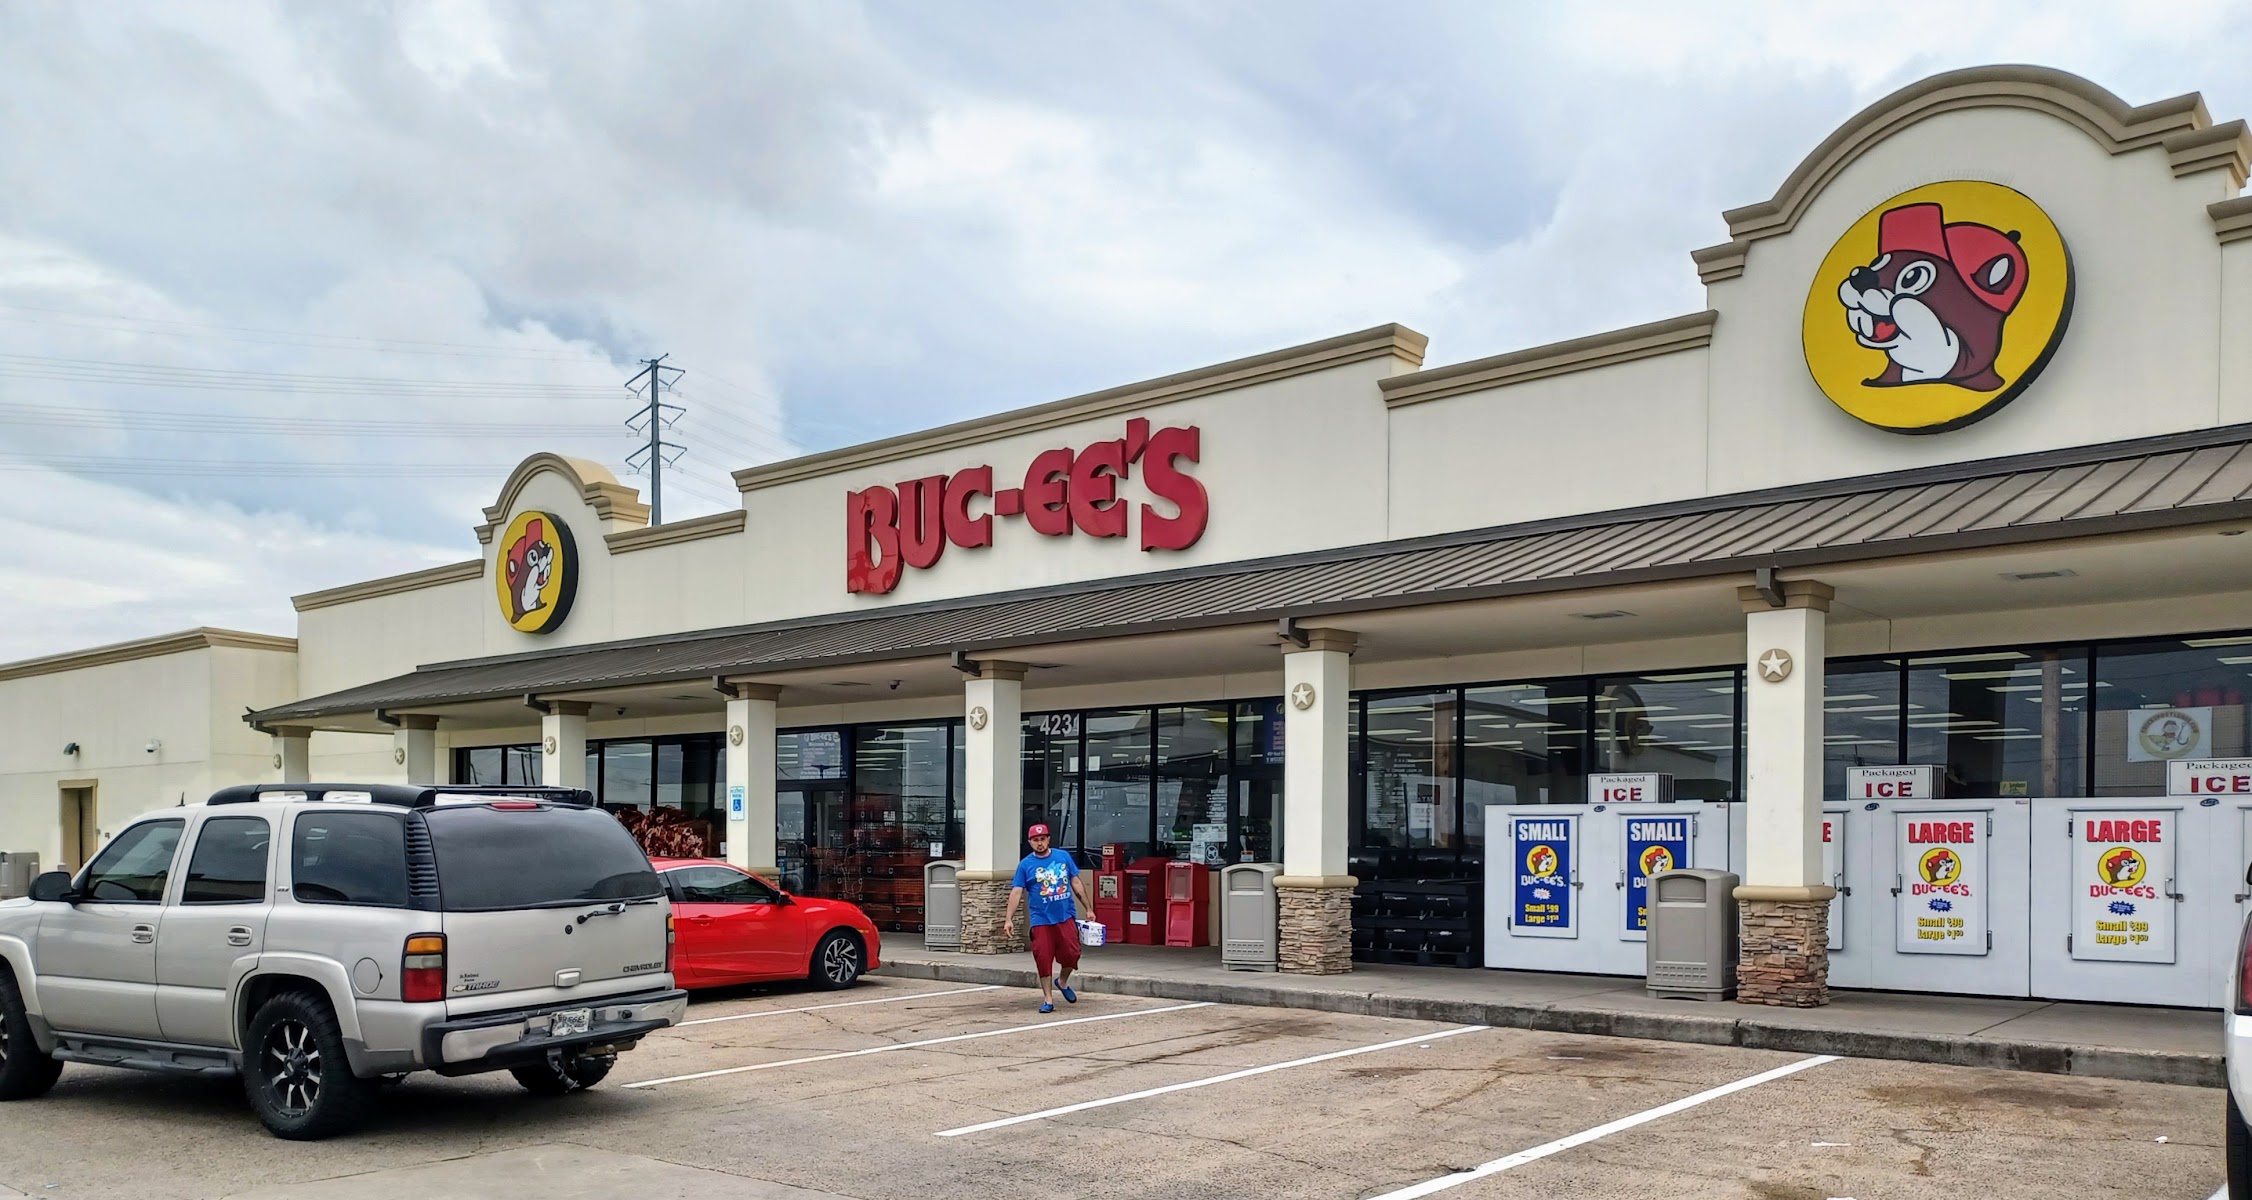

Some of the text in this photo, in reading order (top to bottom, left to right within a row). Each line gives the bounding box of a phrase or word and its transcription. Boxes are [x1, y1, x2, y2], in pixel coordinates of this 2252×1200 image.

[847, 417, 1209, 594] BUC-EE'S
[1862, 768, 1917, 777] Packaged
[1600, 776, 1646, 784] Packaged
[2191, 775, 2251, 793] ICE
[1603, 787, 1643, 802] ICE
[1865, 781, 1913, 798] ICE
[1518, 822, 1567, 842] SMALL
[1630, 822, 1684, 842] SMALL
[1908, 822, 1975, 844] LARGE
[2086, 820, 2162, 843] LARGE
[1525, 904, 1546, 913] Small
[1525, 914, 1546, 924] Large
[1917, 916, 1945, 928] Small
[2096, 919, 2127, 931] Small
[1917, 929, 1945, 940] Large
[2096, 933, 2127, 945] Large
[466, 980, 500, 991] TAHOE
